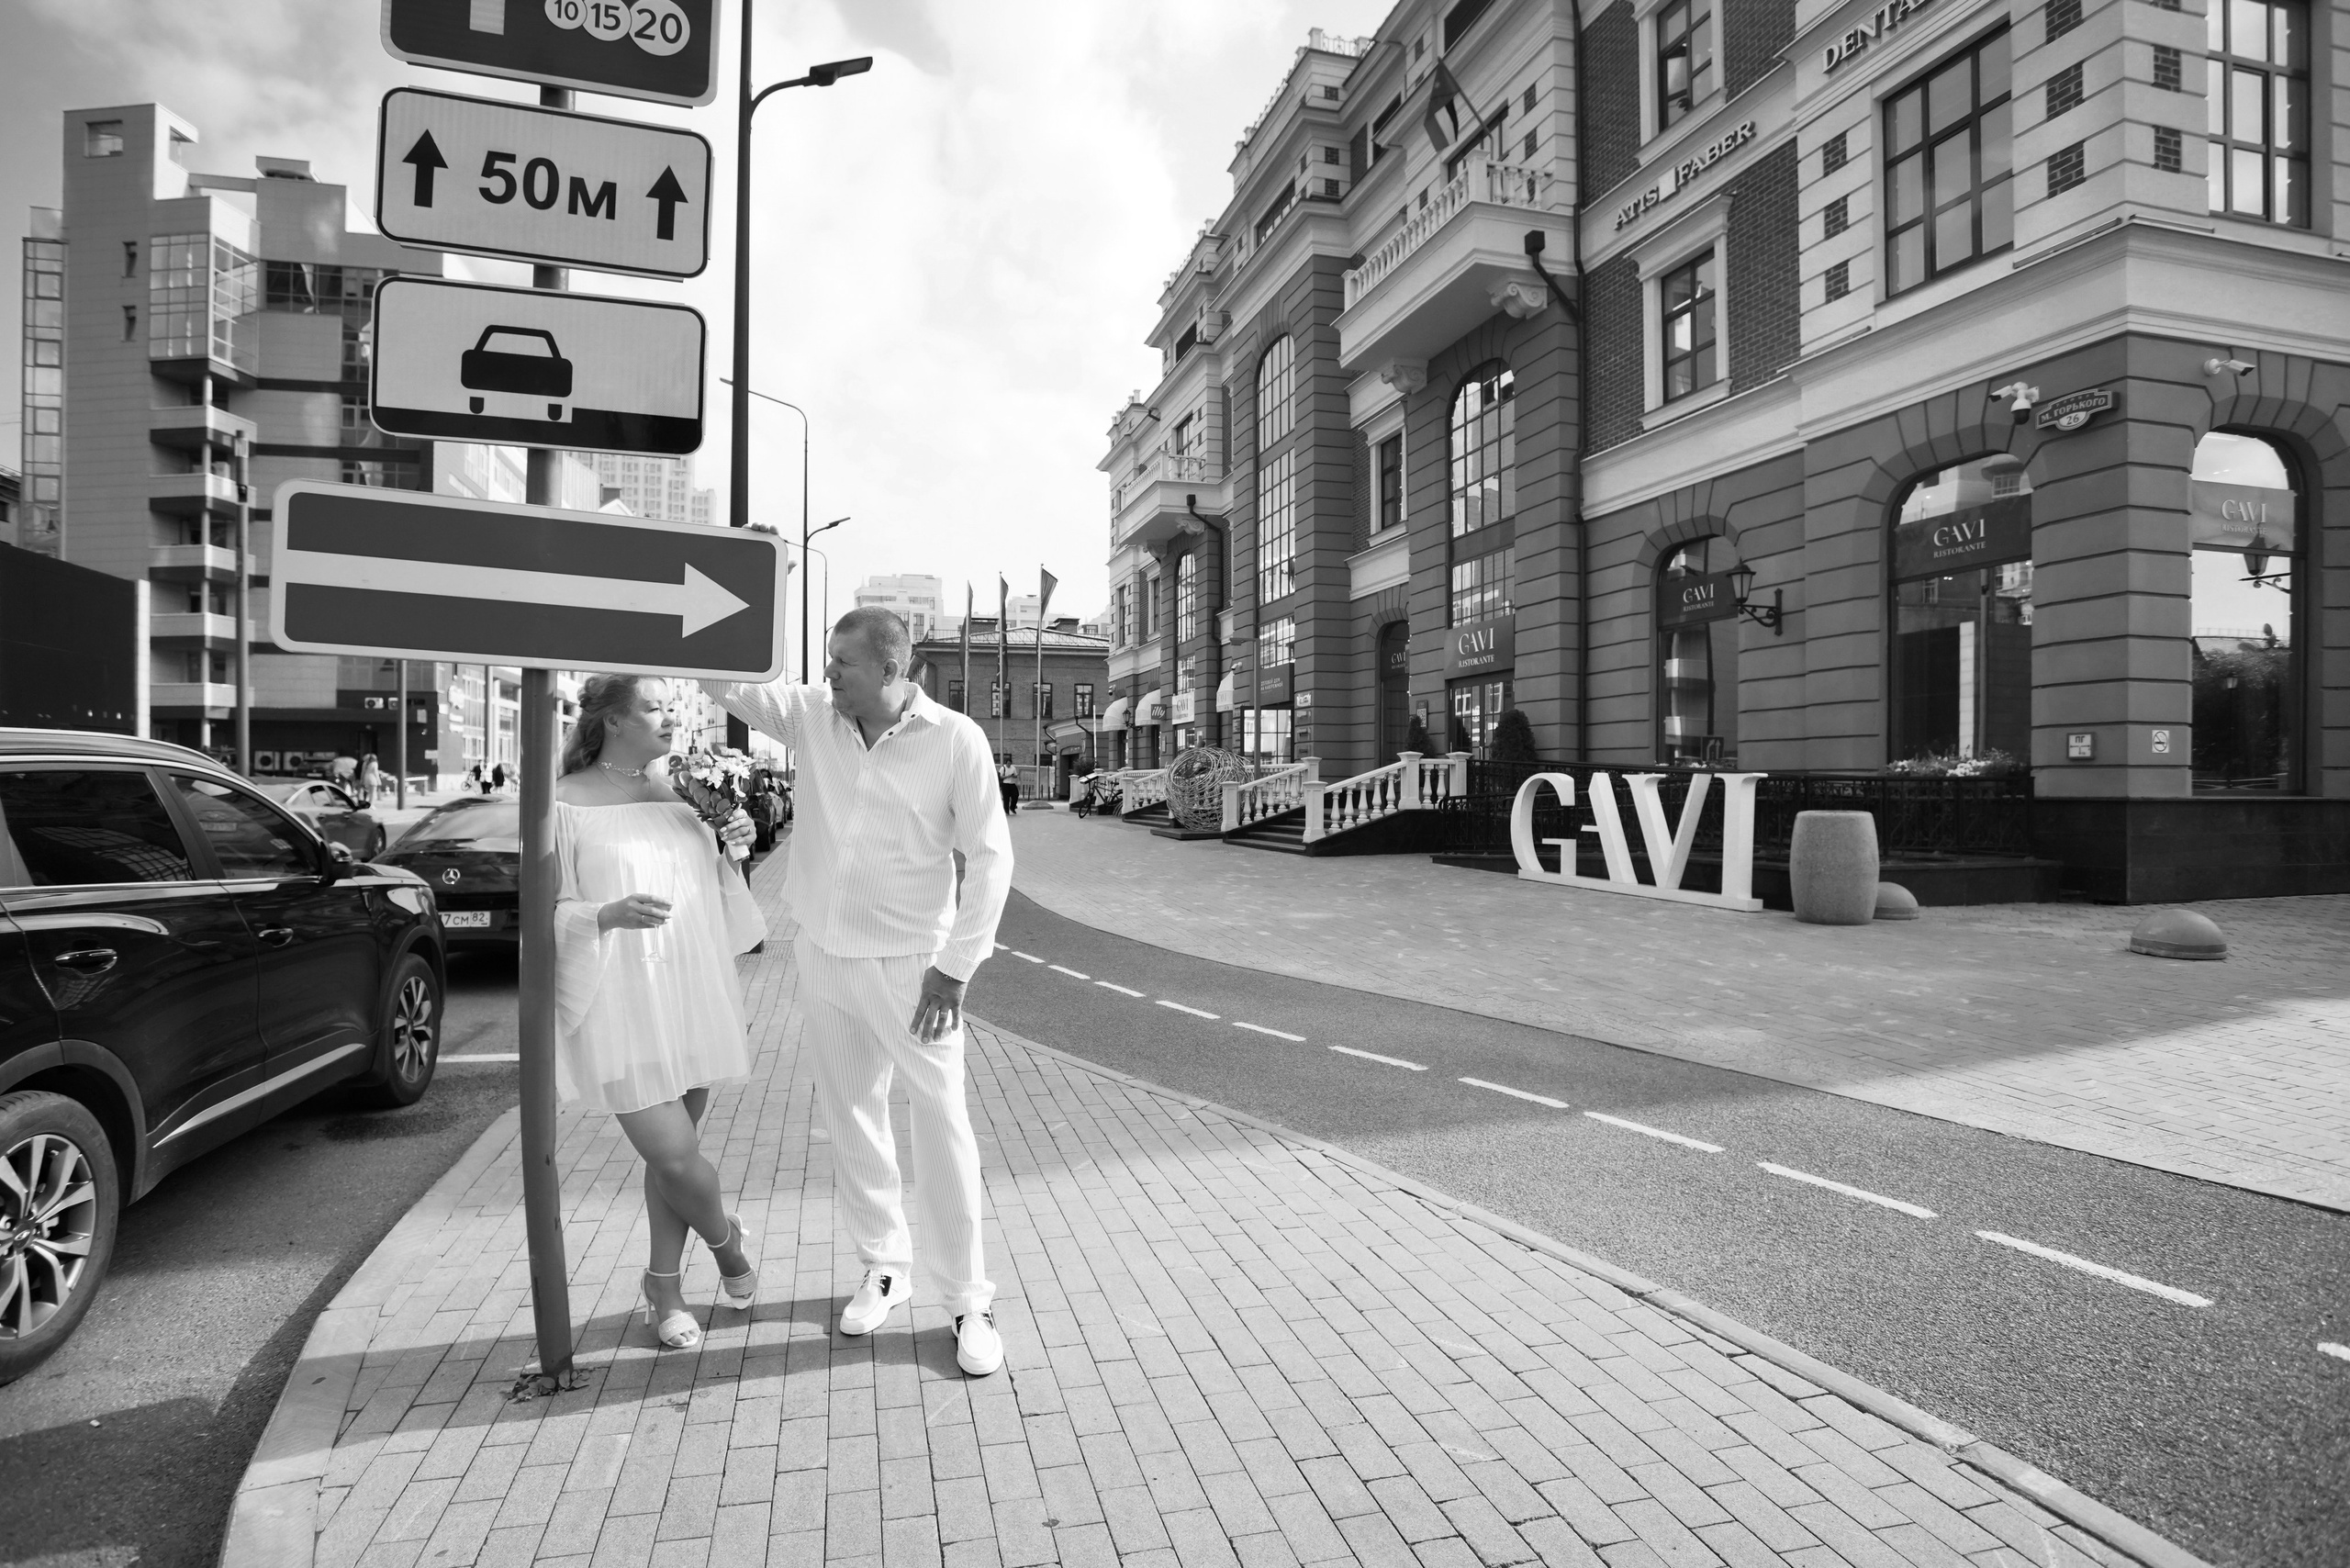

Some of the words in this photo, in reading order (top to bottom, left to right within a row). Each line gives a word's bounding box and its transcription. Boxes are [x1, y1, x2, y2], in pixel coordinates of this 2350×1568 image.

[554, 0, 578, 20] 10
[590, 3, 621, 31] 15
[634, 8, 682, 44] 20
[1615, 186, 1659, 230] ATIS
[1677, 120, 1757, 186] FABER
[2053, 397, 2106, 417] ГОРЬКОГО
[2066, 414, 2079, 425] 26
[2221, 499, 2266, 523] GAVI
[1933, 519, 1985, 546] GAVI
[1933, 541, 1986, 558] RISTORANTE
[1683, 583, 1714, 603] GAVI
[1458, 627, 1494, 655] GAVI
[1391, 651, 1406, 664] GAVI
[1458, 654, 1495, 668] RISTORANTE
[1151, 706, 1165, 719] illy
[2075, 735, 2085, 744] ПГ
[1511, 772, 1768, 900] GAVI
